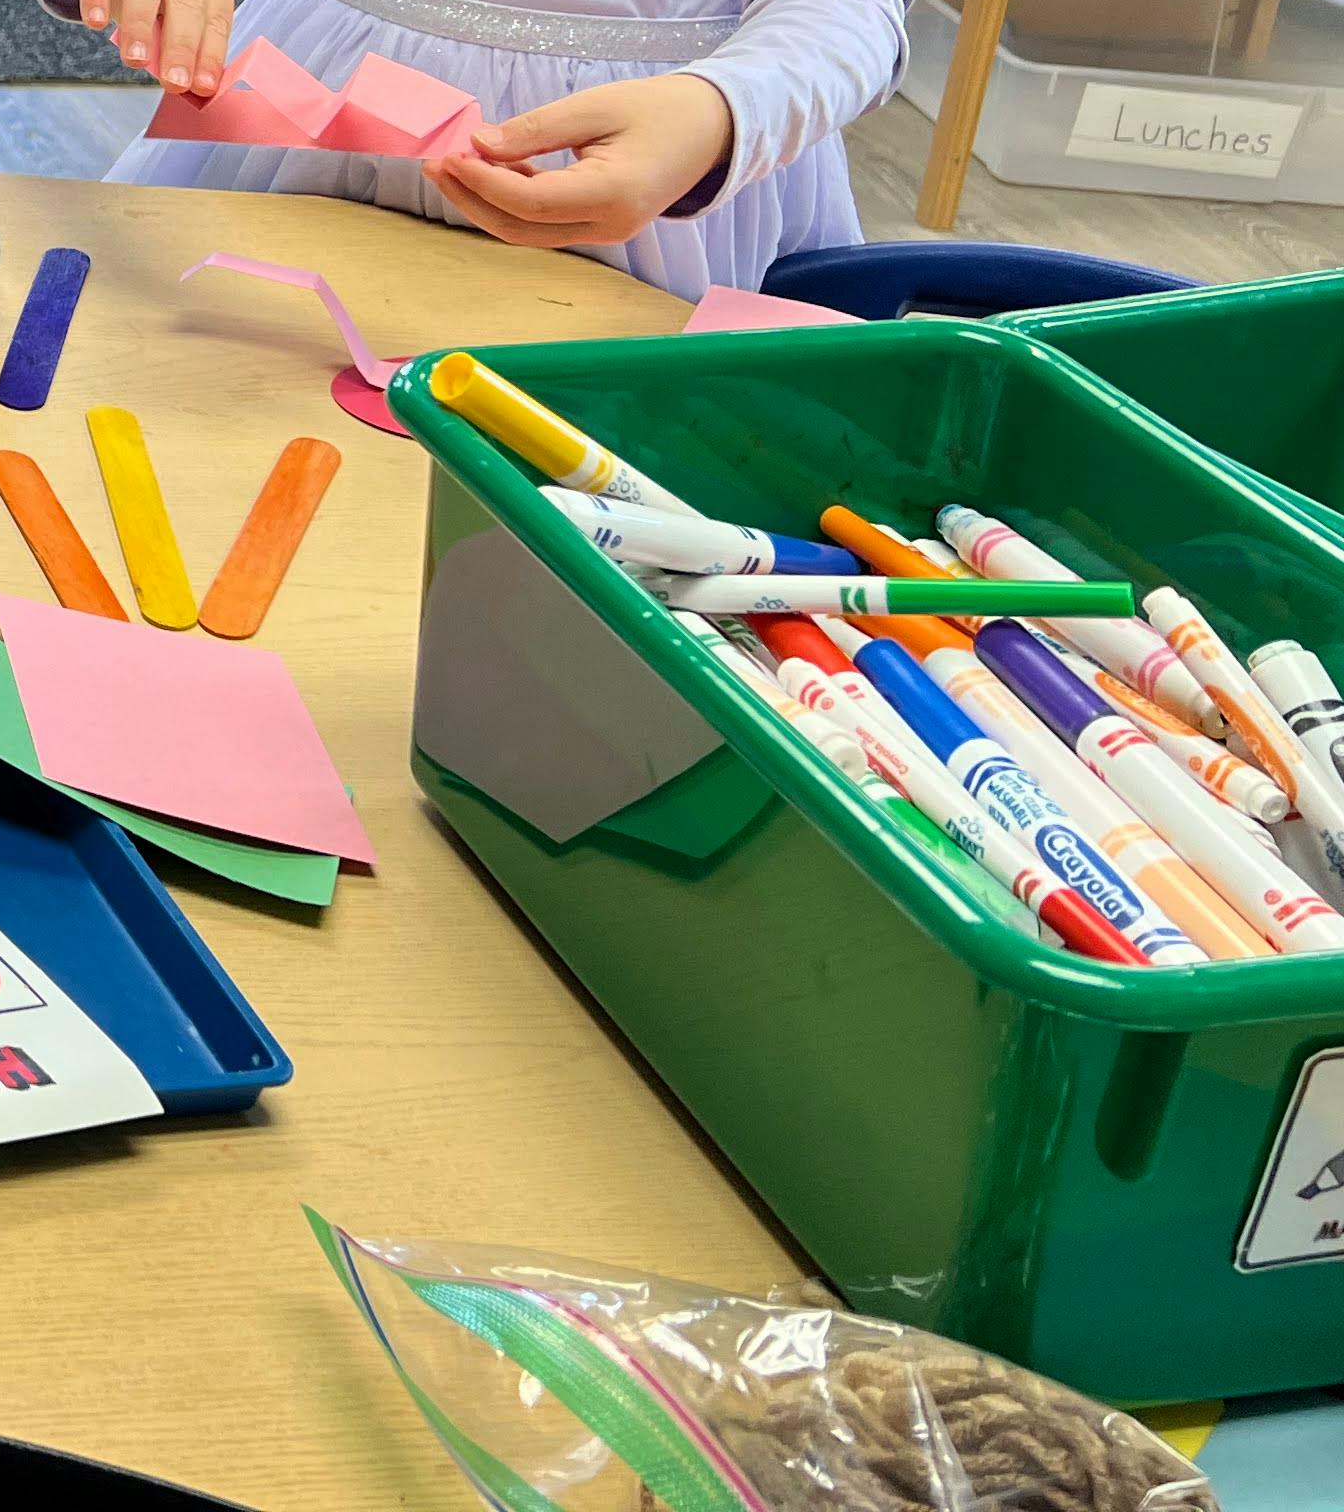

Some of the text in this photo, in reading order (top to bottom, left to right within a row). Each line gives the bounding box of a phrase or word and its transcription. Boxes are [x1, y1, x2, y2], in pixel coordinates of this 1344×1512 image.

[1113, 103, 1273, 156] Lunches
[855, 726, 909, 776] Crayola.com
[987, 779, 1032, 831] WASHABLE
[1044, 830, 1126, 921] Crayola
